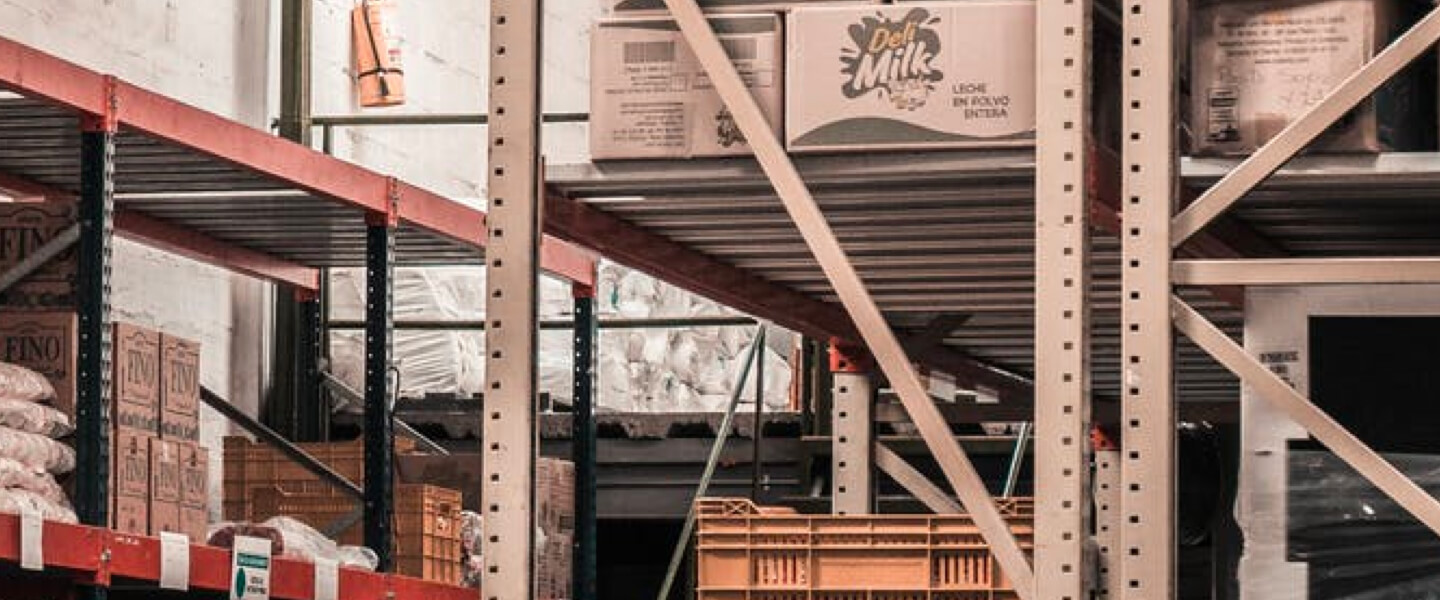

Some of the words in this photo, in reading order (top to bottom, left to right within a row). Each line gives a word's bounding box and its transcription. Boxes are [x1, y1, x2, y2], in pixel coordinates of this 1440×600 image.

[868, 22, 917, 53] Deli
[854, 41, 934, 90] Milk
[952, 83, 987, 94] LECHE
[953, 97, 968, 107] EN
[971, 96, 1010, 107] POLVO
[6, 336, 60, 361] FINO
[128, 349, 155, 388] FINO
